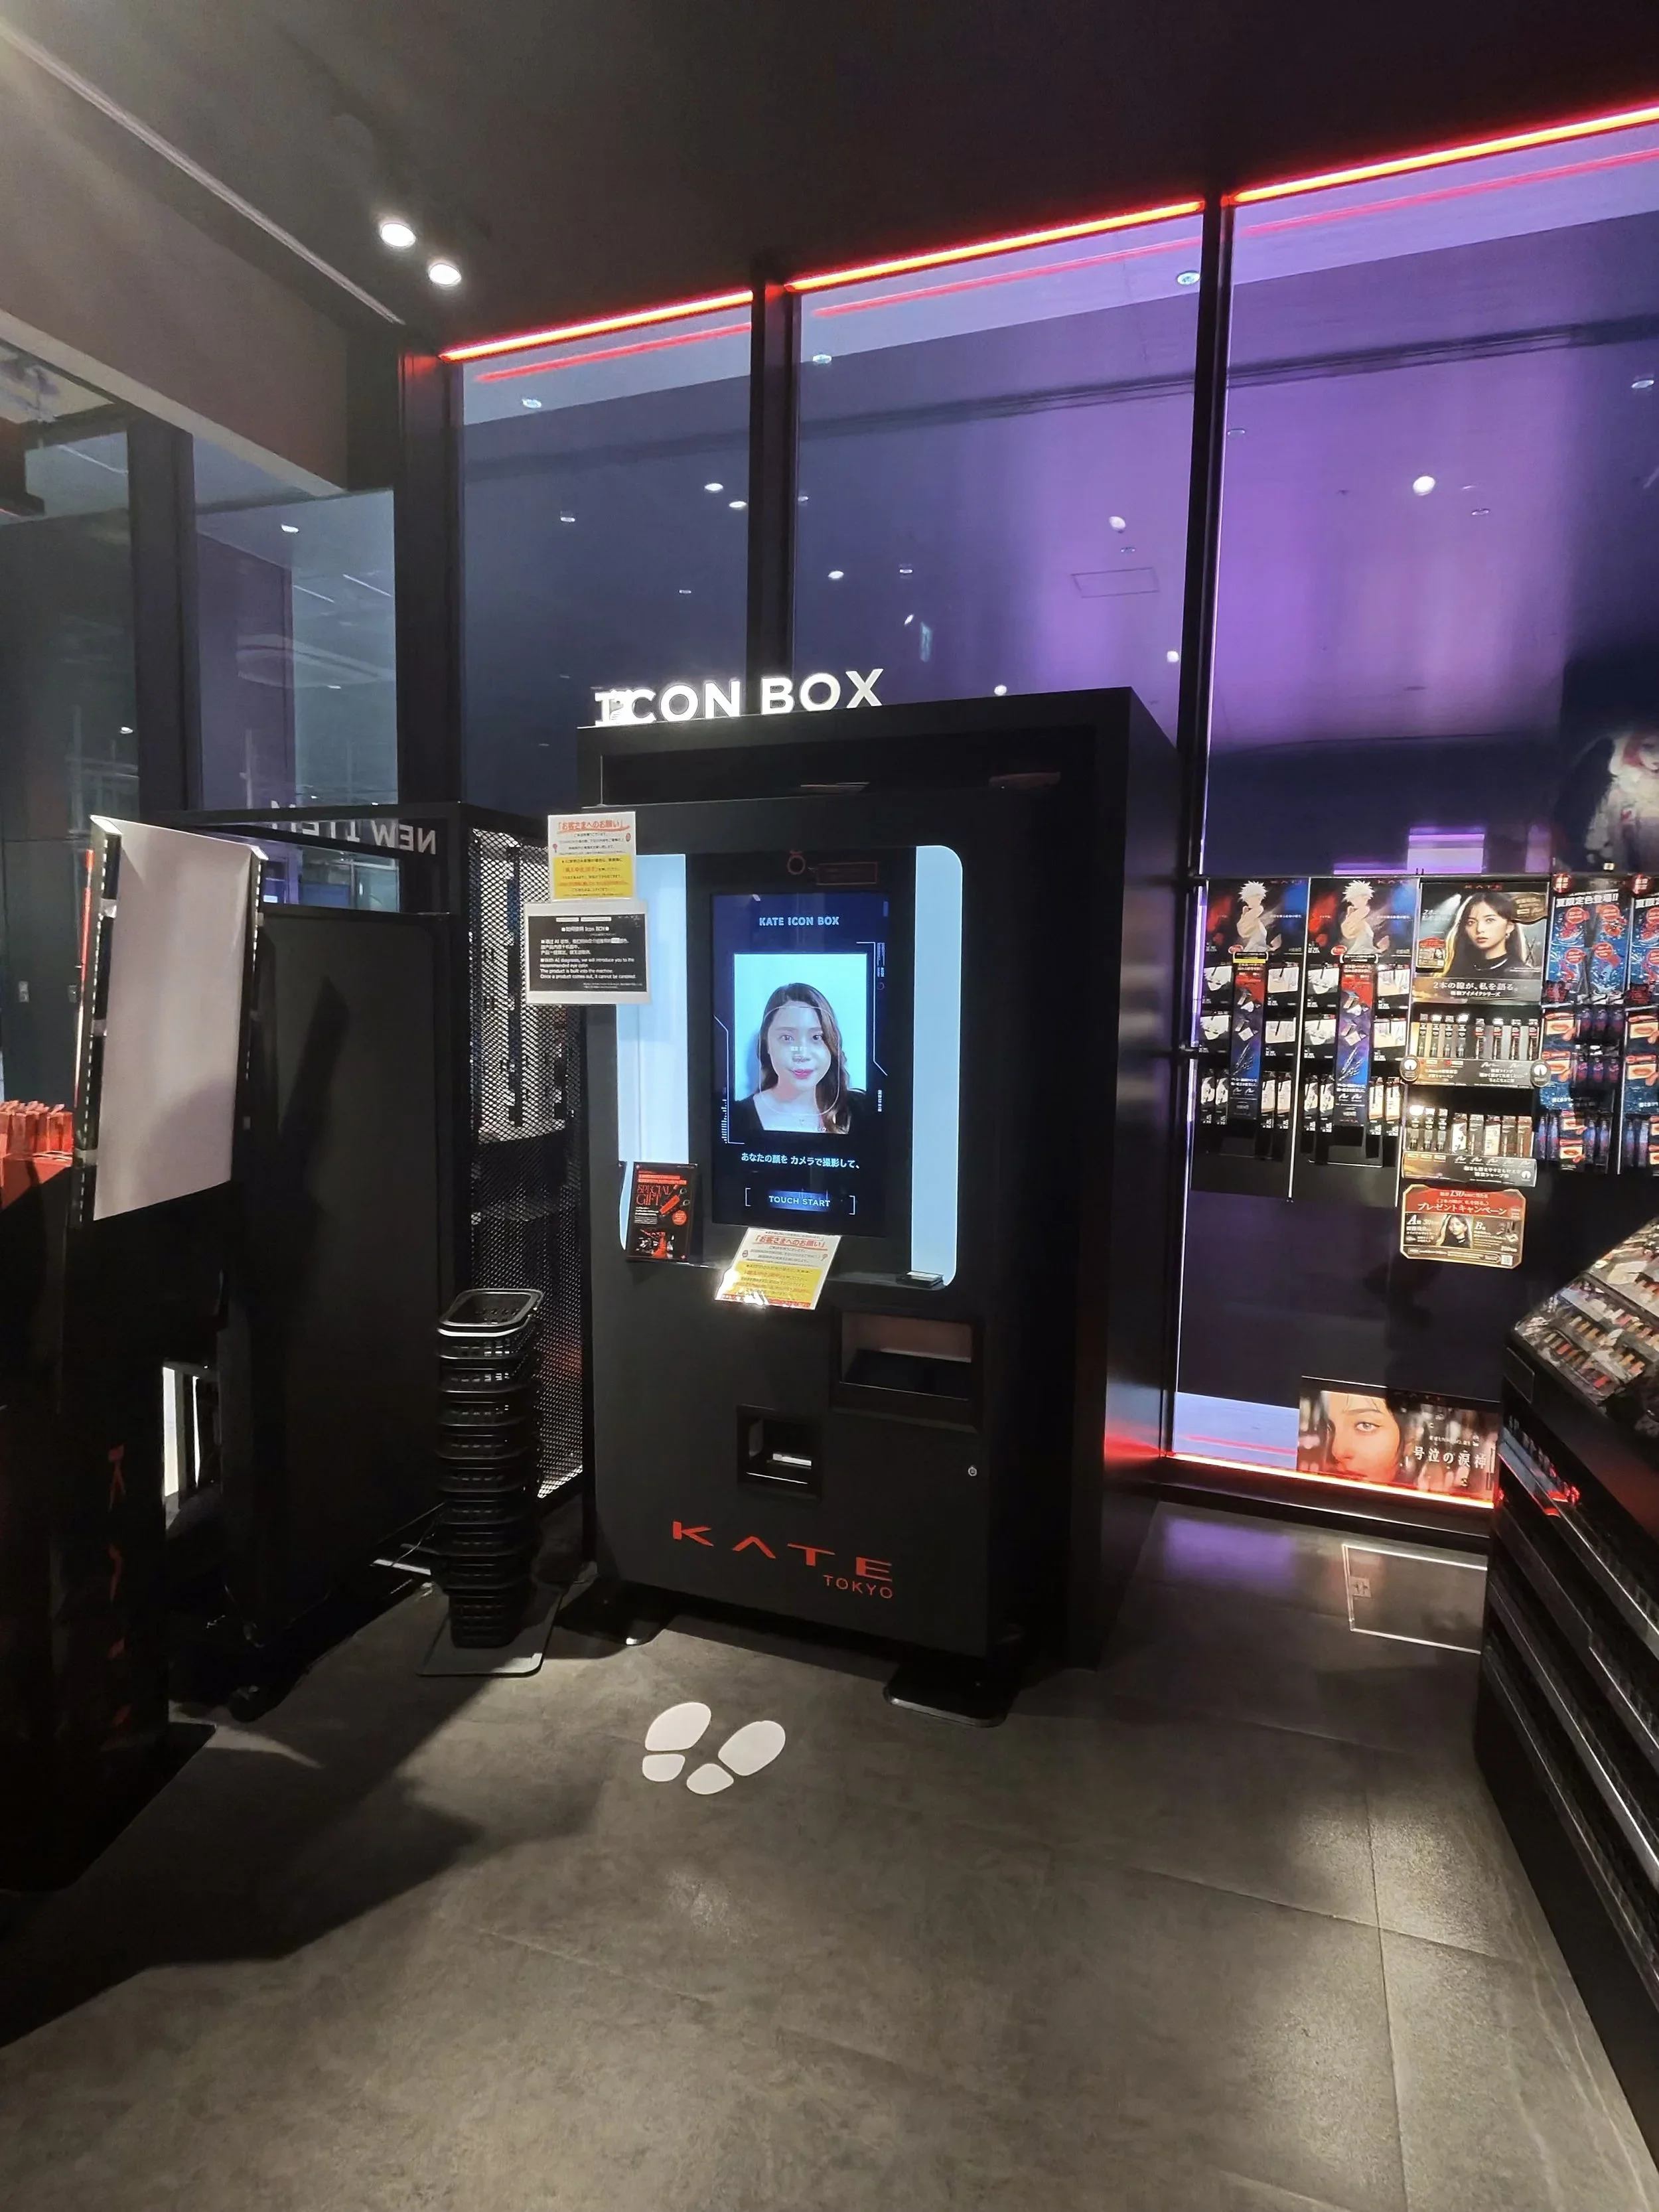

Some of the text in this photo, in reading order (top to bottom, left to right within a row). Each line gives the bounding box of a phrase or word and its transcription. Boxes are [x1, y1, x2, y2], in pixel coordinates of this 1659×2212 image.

[595, 668, 884, 726] ICON BOX
[759, 916, 839, 926] KATE ICON BOX
[1433, 982, 1519, 991] 2本の線が、私を語る。
[741, 1152, 861, 1169] あなたの顔を カメラで撮影して、
[637, 1185, 672, 1195] SPECIAL
[636, 1193, 661, 1206] GIFT
[768, 1195, 831, 1207] TOUCH START
[1417, 1203, 1508, 1215] プレゼントキャンペーン
[755, 1235, 826, 1248] 「お客さまへのお願い」
[672, 1520, 893, 1583] KATE
[823, 1574, 893, 1599] TOKYO
